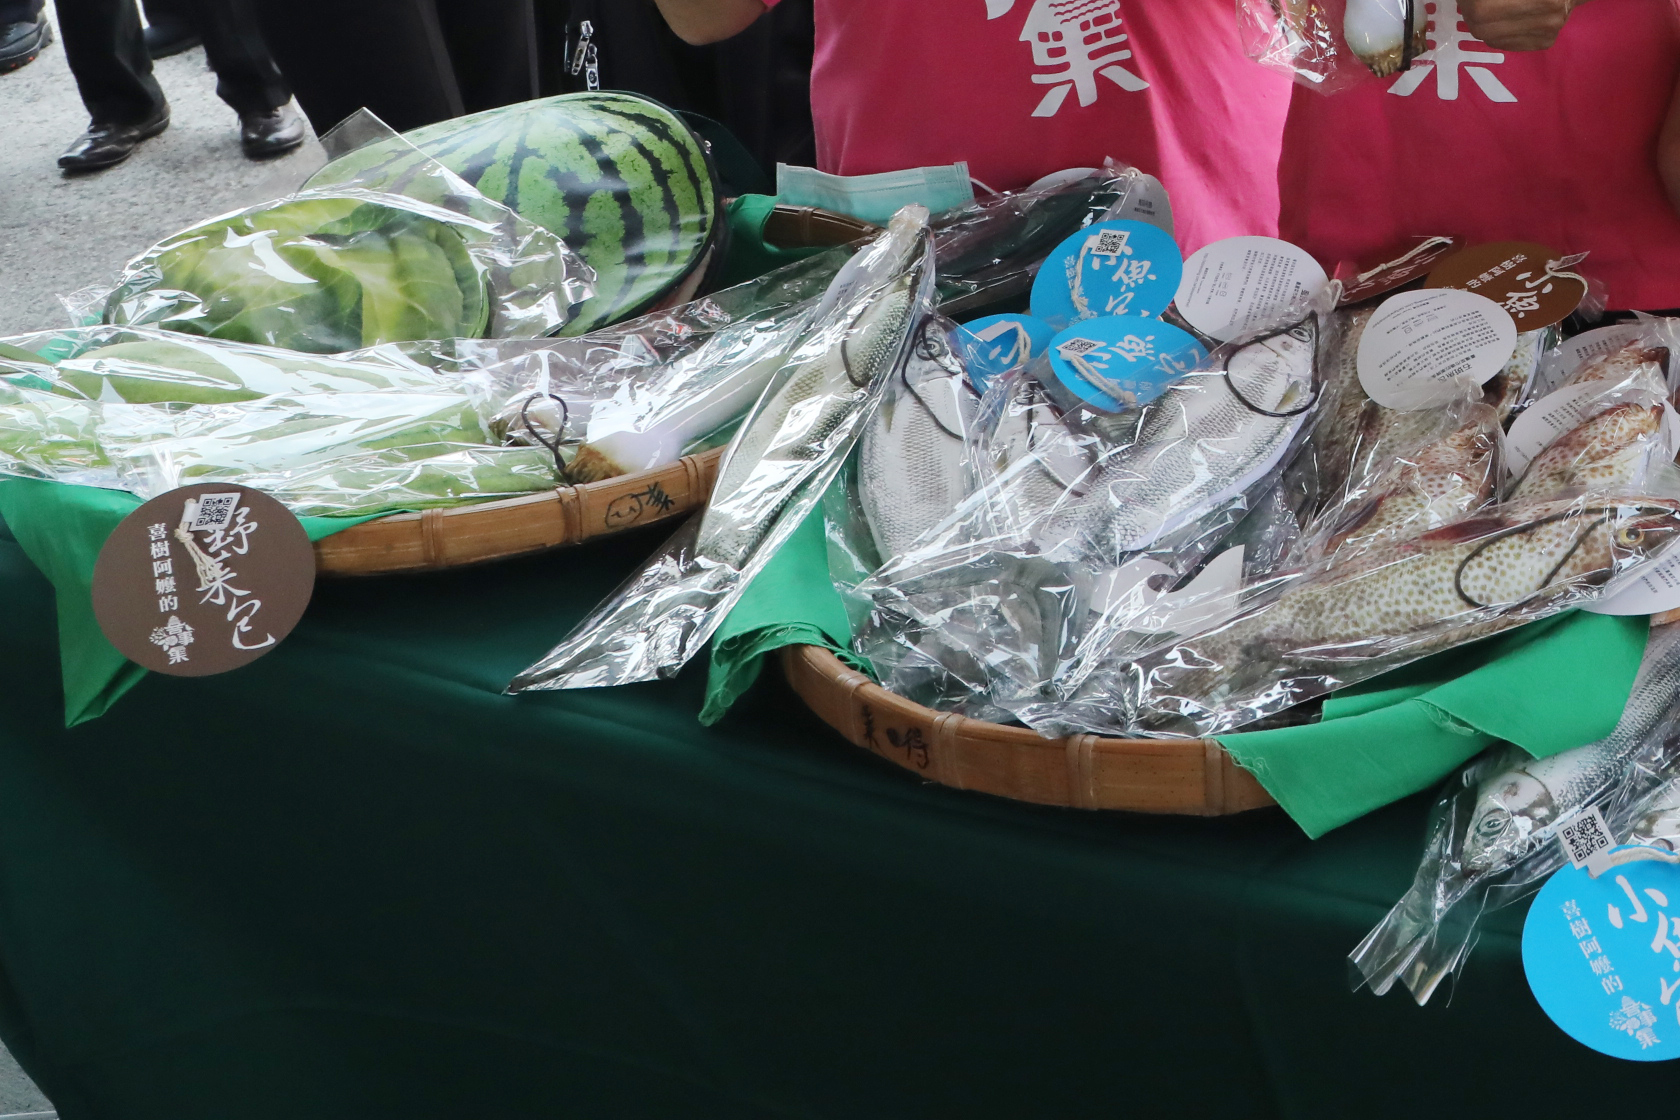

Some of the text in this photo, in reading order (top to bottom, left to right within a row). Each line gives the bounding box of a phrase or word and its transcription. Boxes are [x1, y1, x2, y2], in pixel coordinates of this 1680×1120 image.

[147, 522, 179, 613] 喜樹阿嬤的
[1560, 898, 1624, 996] 喜樹阿嬤的
